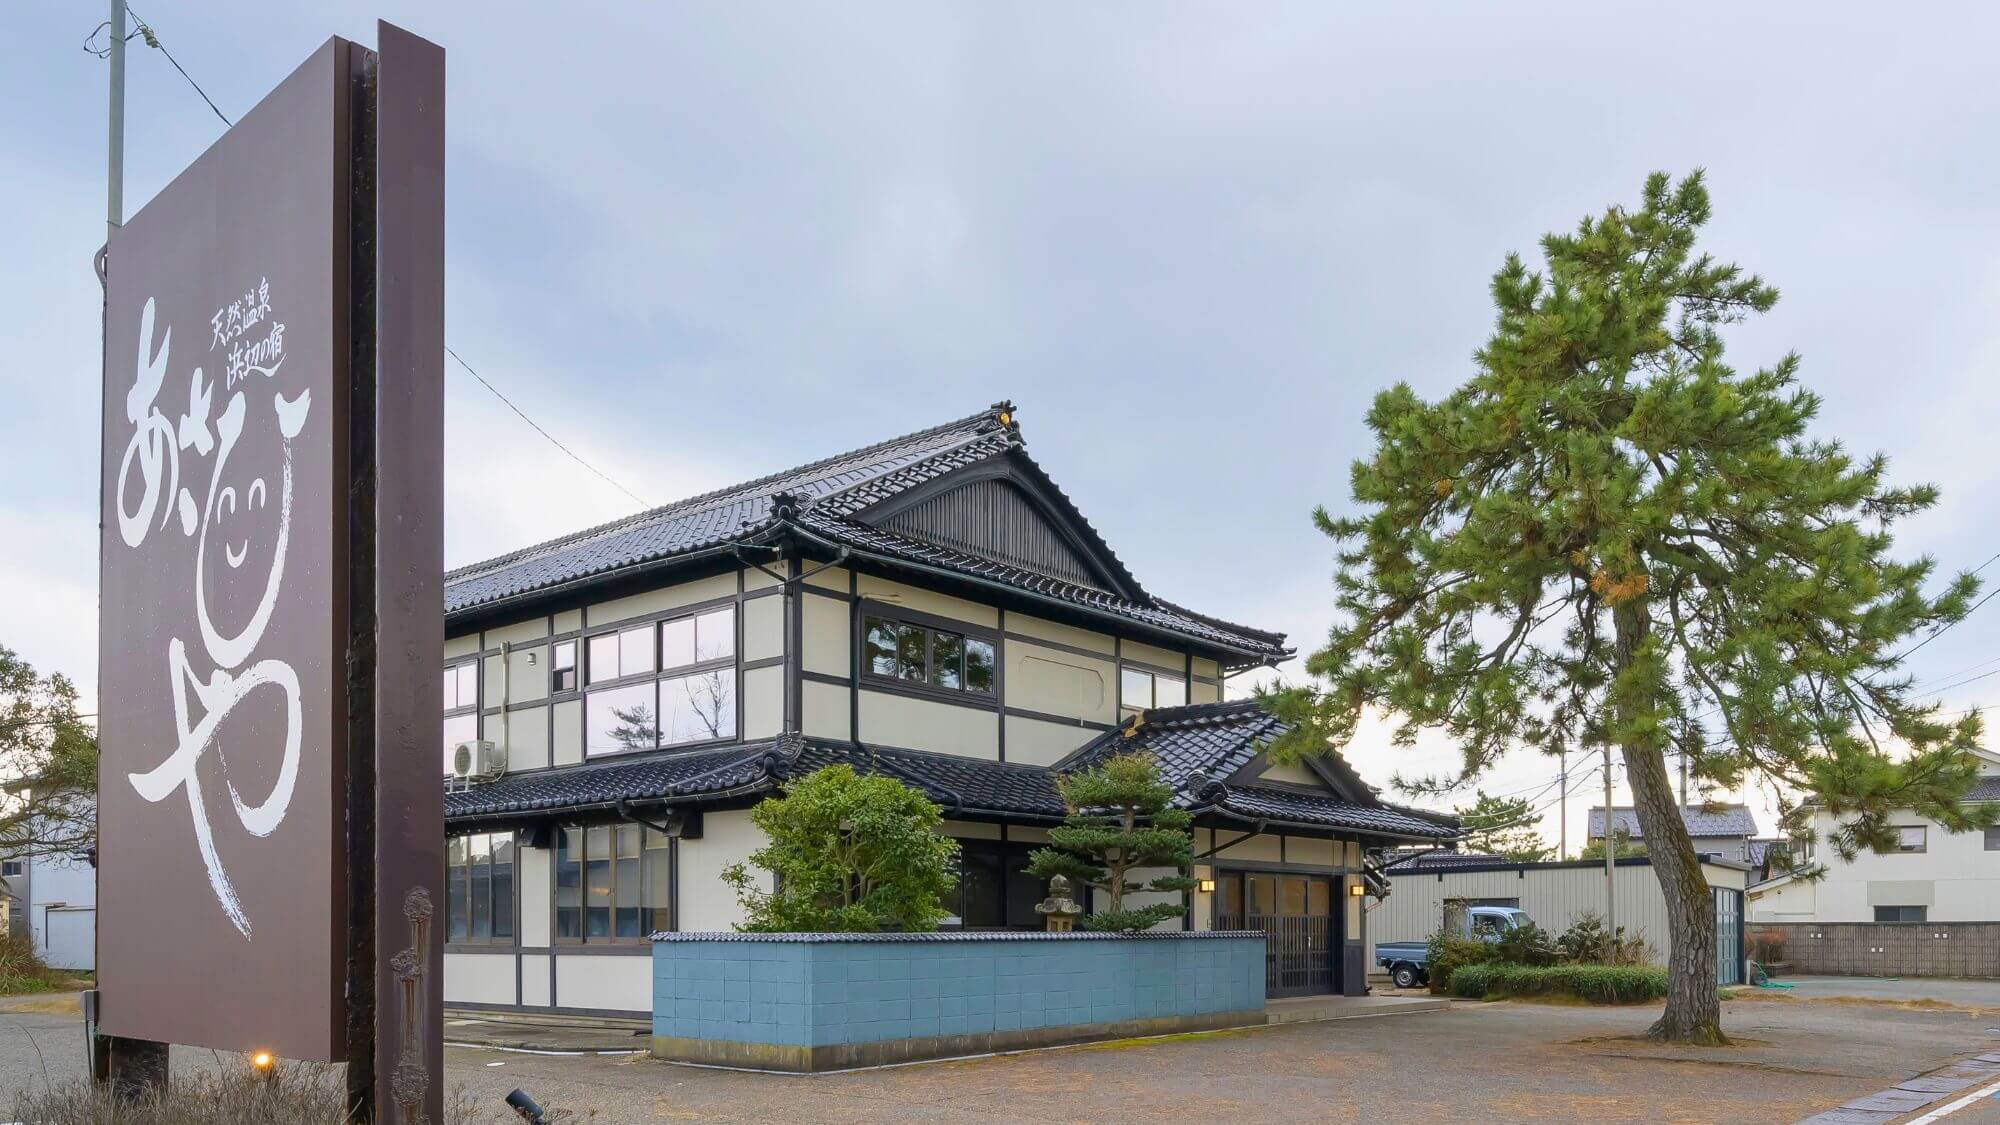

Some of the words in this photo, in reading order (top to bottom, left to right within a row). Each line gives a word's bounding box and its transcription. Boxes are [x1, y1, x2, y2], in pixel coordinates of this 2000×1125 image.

[209, 276, 272, 351] 天然温泉
[226, 321, 287, 391] 浜辺の宿
